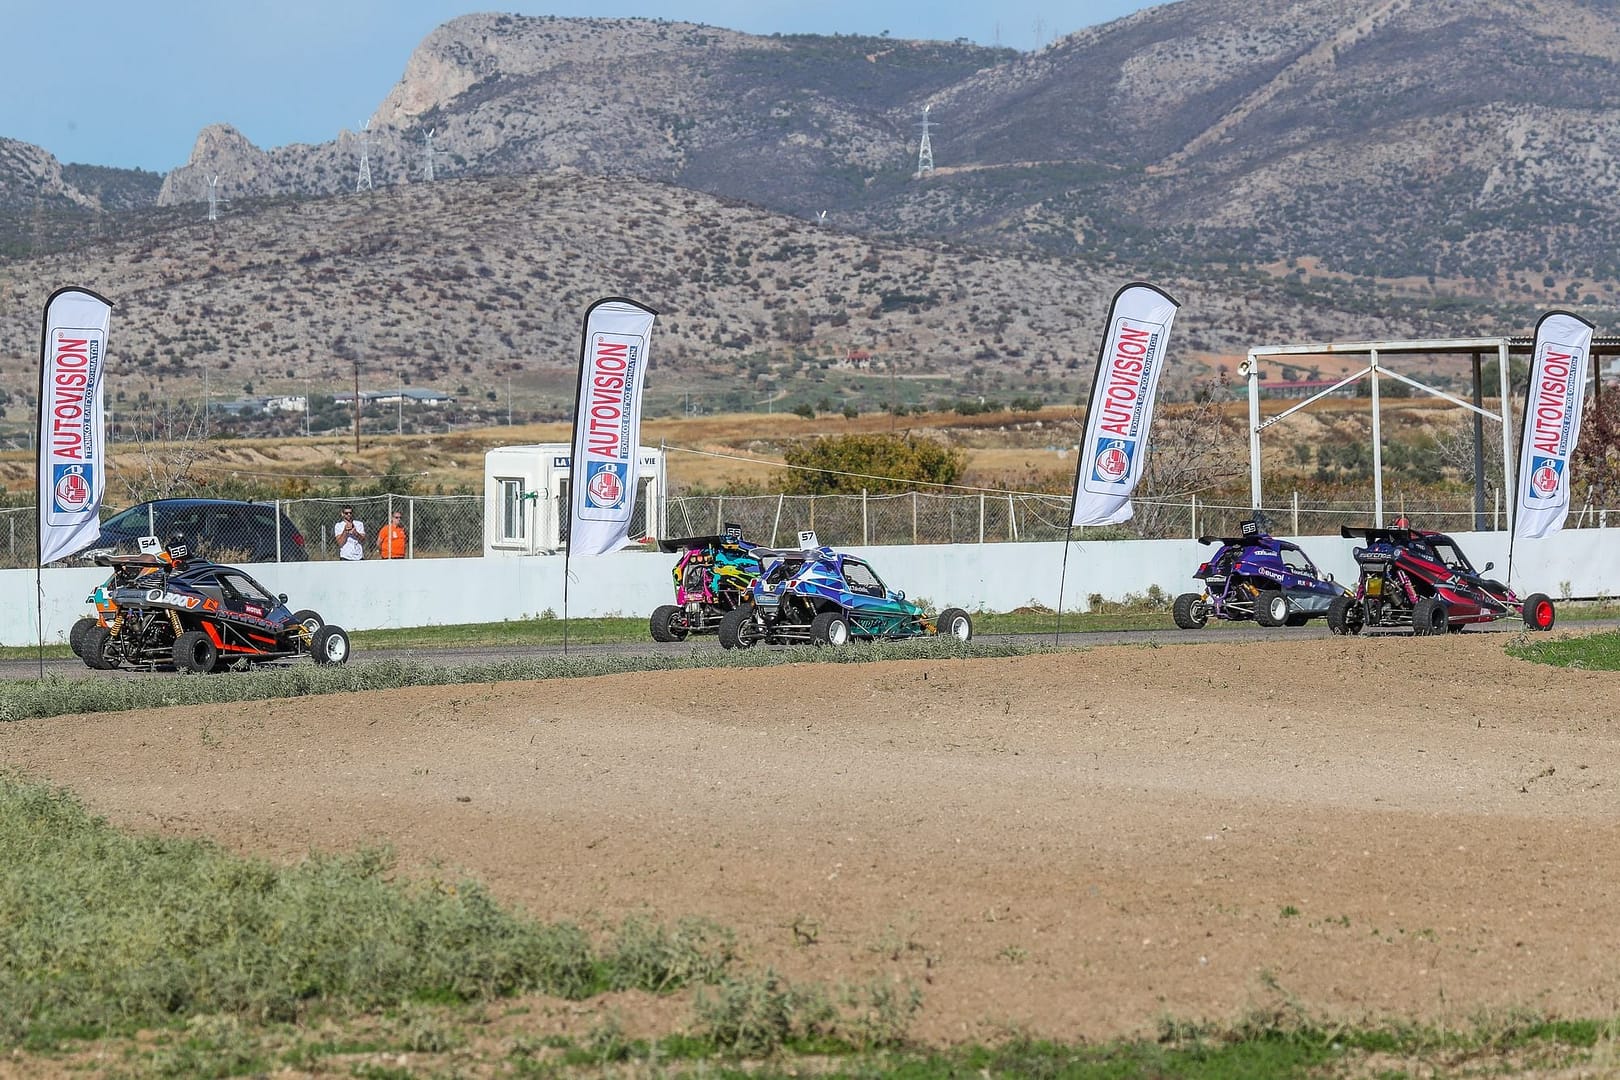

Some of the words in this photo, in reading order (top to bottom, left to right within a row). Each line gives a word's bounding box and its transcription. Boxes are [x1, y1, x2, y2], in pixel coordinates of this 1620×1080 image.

[626, 347, 636, 388] ΟΧΗΜΑΤΩΝ
[1101, 328, 1149, 435] AUTOVISION
[54, 339, 87, 459] AUTOVISION
[84, 387, 93, 419] ΕΛΕΓΧΟΣ
[588, 343, 627, 458] AUTOVISION
[624, 390, 632, 420] ΕΛΕΓΧΟΣ
[1534, 352, 1570, 454] AUTOVISION
[555, 458, 566, 466] LA
[142, 539, 156, 548] 54
[802, 532, 814, 540] 57
[1244, 524, 1256, 534] 55
[172, 546, 186, 558] 59
